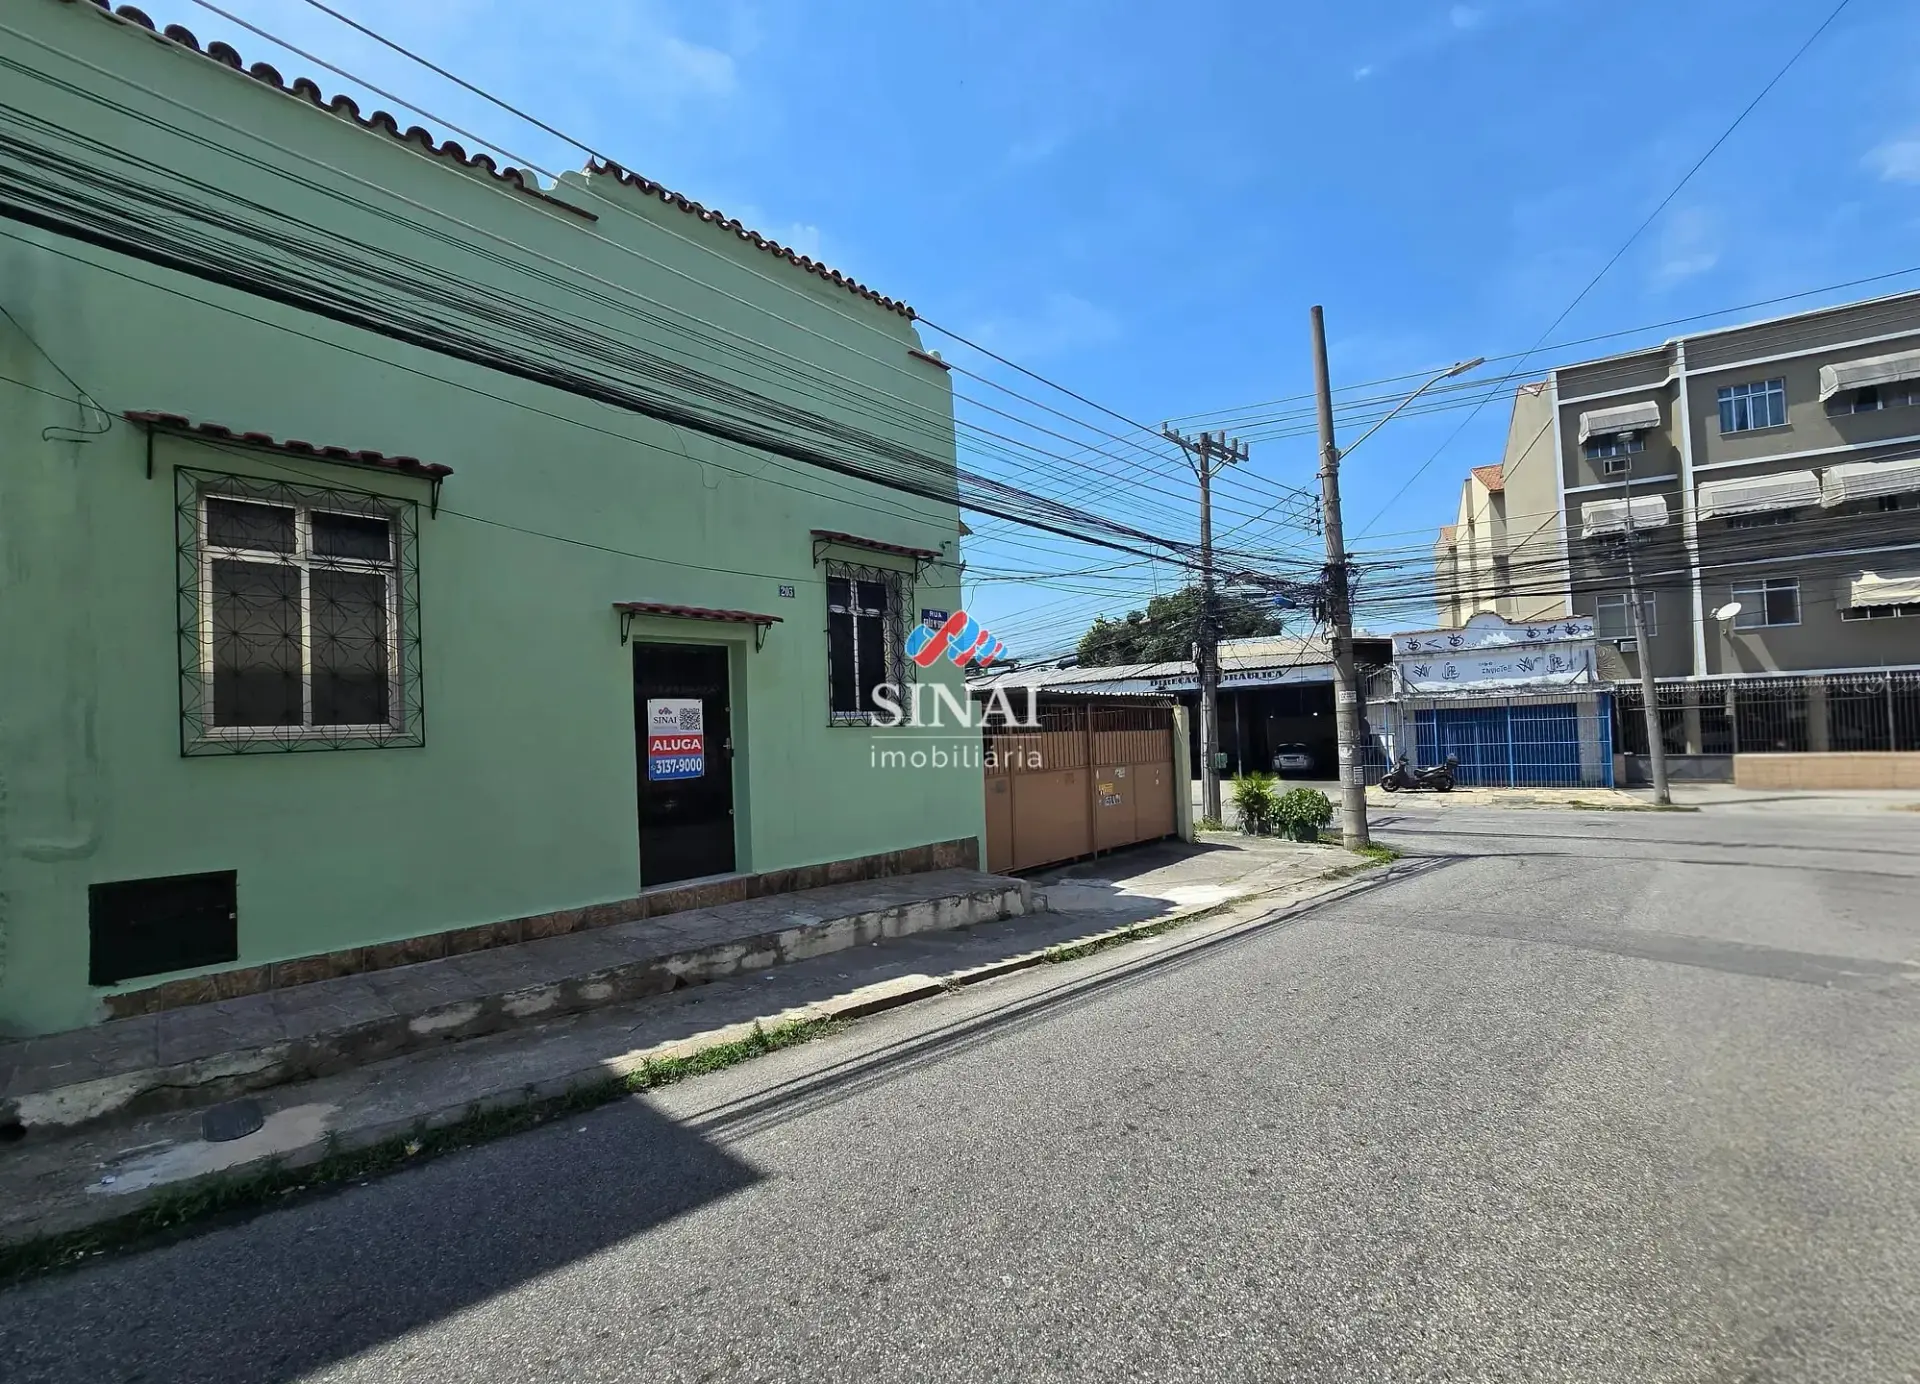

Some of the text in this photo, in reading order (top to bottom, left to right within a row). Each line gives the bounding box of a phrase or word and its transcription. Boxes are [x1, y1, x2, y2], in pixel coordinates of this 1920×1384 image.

[929, 610, 942, 618] RUA
[653, 716, 677, 724] SINAI
[652, 739, 701, 751] ALUGA
[656, 758, 702, 774] 3137-9000
